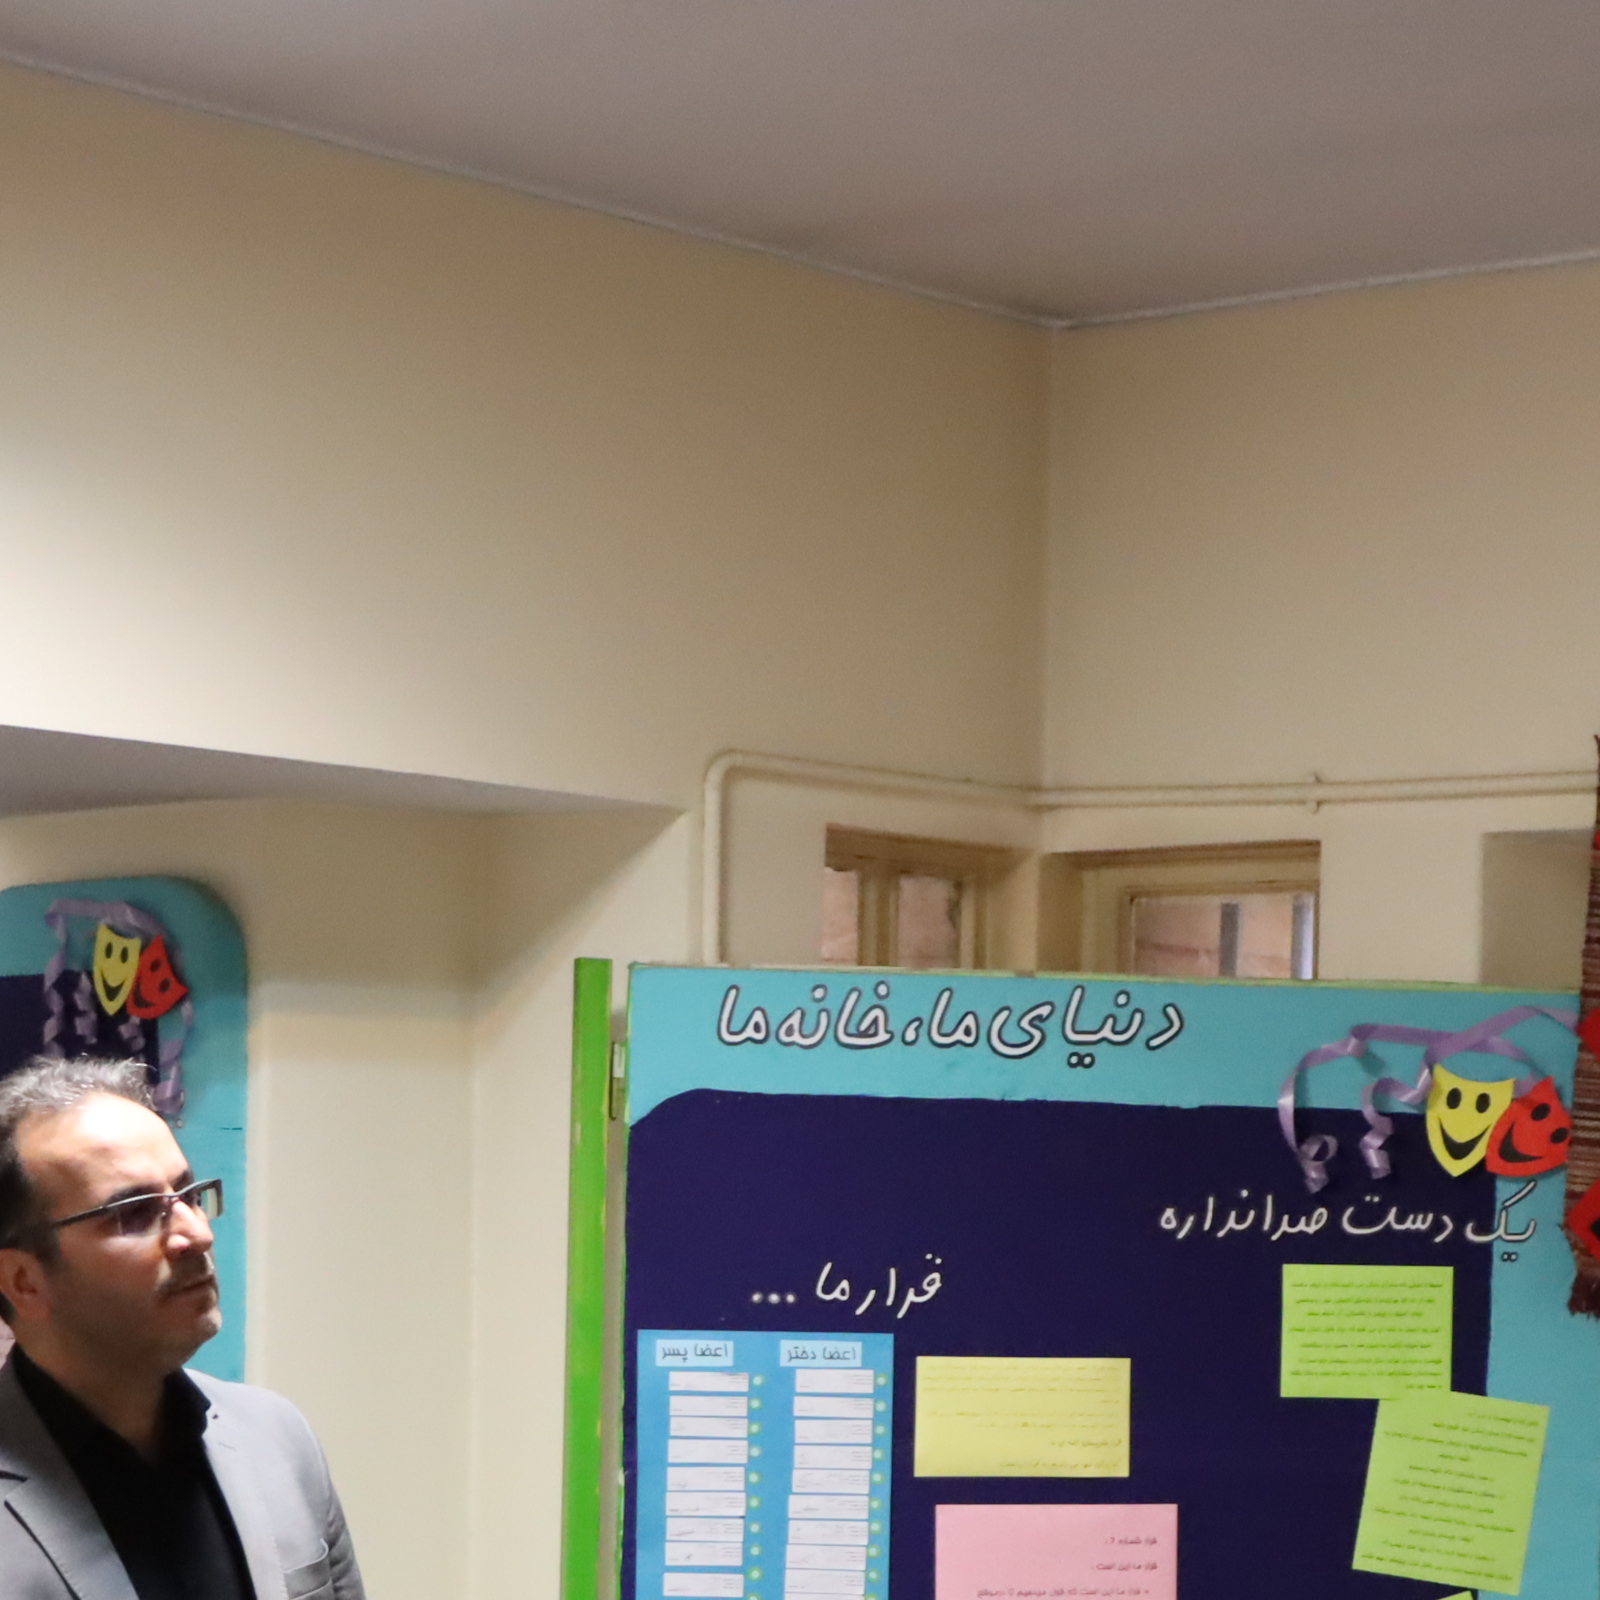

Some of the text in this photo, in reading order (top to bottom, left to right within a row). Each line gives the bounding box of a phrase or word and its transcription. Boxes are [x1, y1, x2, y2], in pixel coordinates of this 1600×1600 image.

[716, 984, 769, 1046] ما
[775, 979, 894, 1049] خانه
[987, 984, 1184, 1068] دنیای
[1341, 1194, 1455, 1243] دست
[1464, 1179, 1537, 1262] یک
[814, 1261, 851, 1301] ما
[854, 1253, 943, 1319] قرار
[661, 1343, 729, 1363] اعضا پسر
[787, 1346, 857, 1363] اعضا دختر
